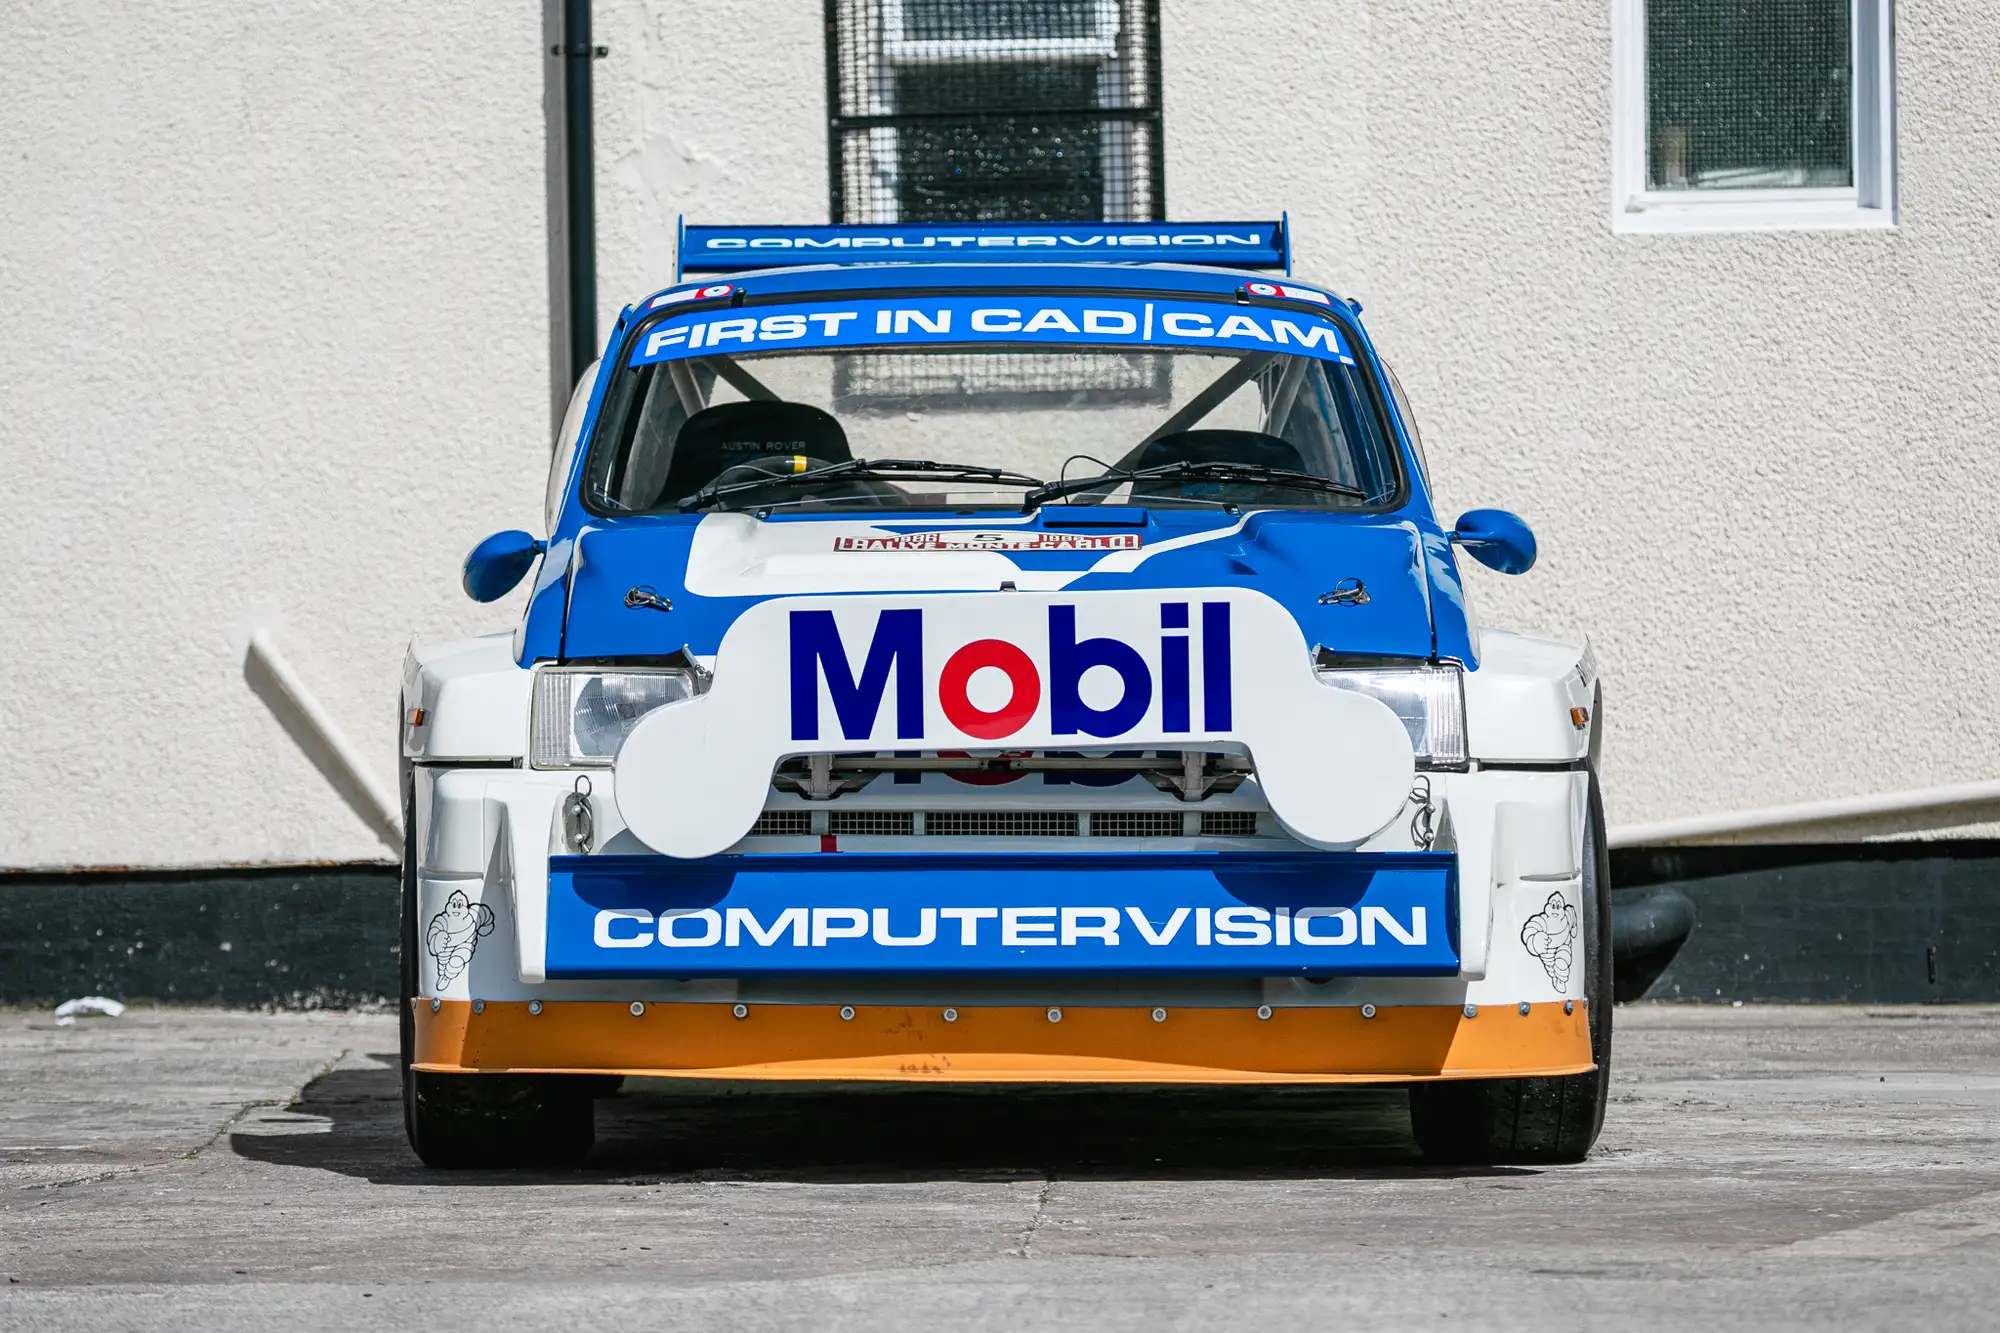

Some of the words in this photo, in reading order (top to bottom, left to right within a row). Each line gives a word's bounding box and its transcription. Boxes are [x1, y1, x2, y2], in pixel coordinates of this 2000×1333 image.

[706, 235, 1262, 249] COMPUTERVISION
[644, 312, 859, 358] FIRST
[875, 309, 952, 334] IN
[720, 440, 761, 451] AUSTIN
[766, 440, 807, 451] ROVER
[852, 537, 937, 550] RALLYE
[945, 536, 1126, 550] MONTE-CARLO
[973, 533, 1004, 542] 5
[789, 602, 1233, 741] Mobil
[593, 906, 1427, 948] COMPUTERVISION
